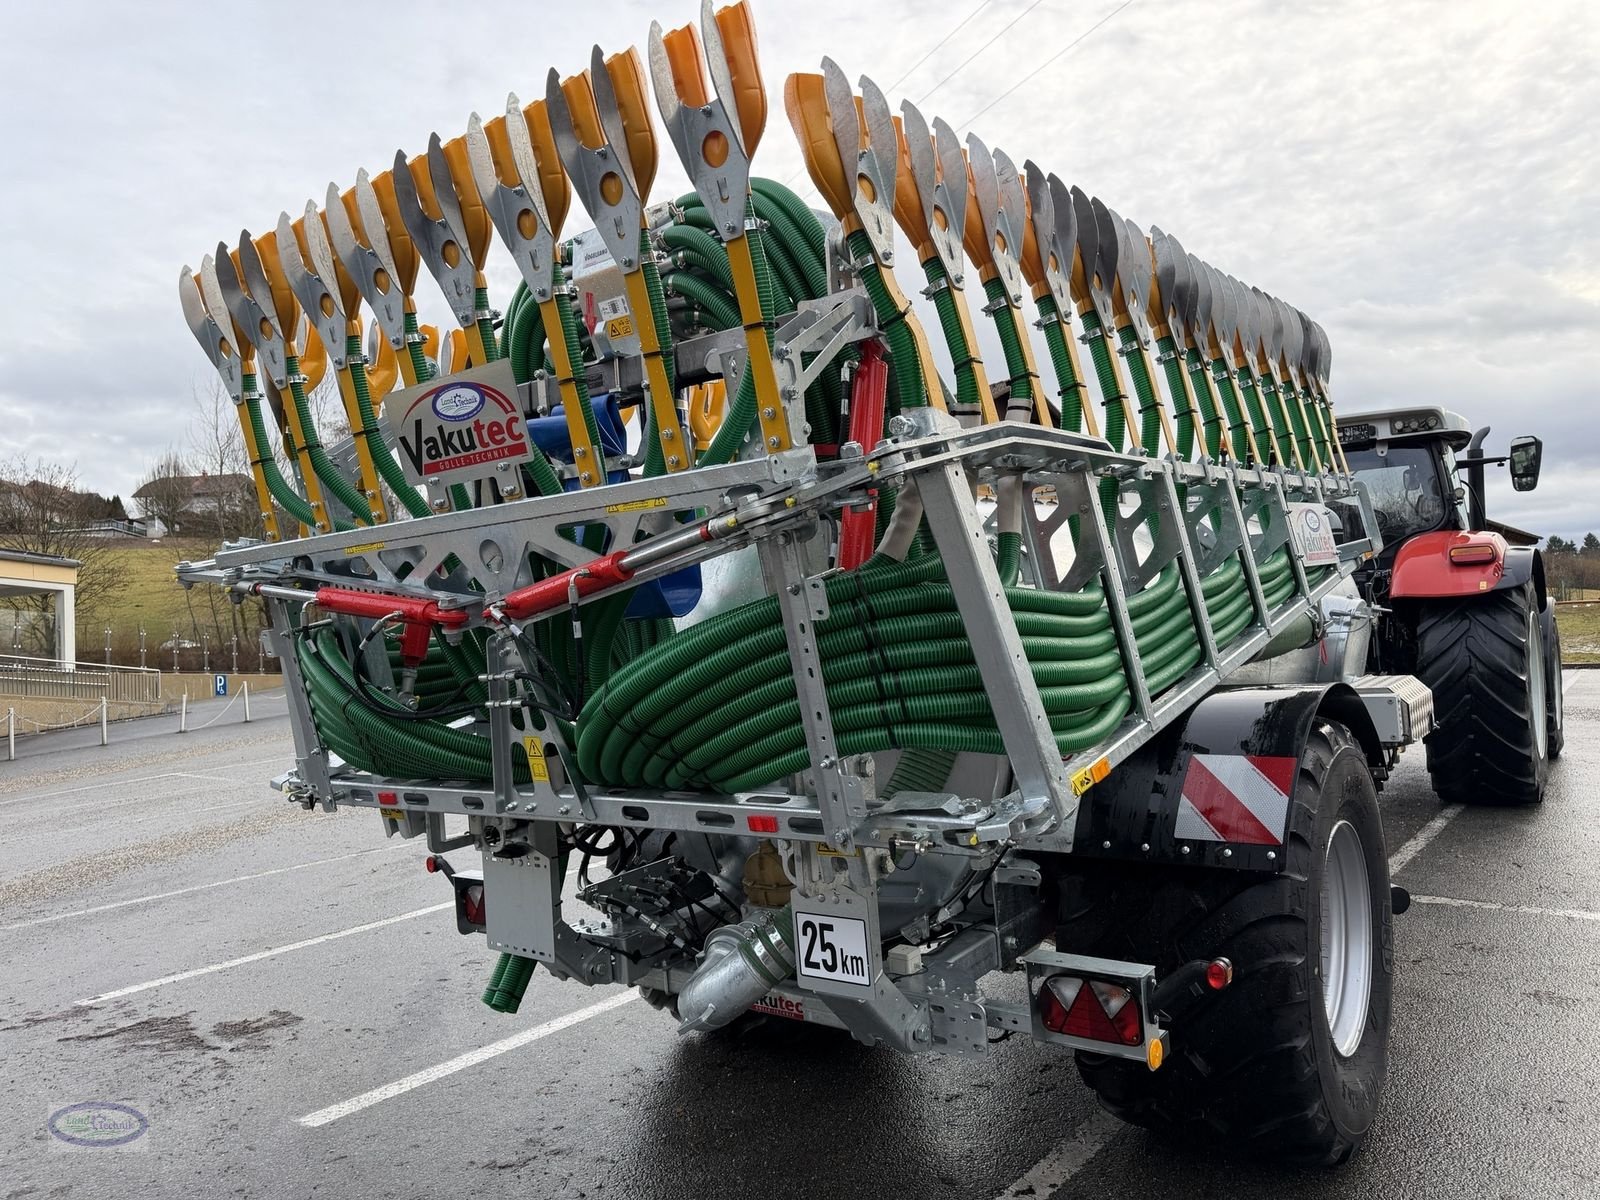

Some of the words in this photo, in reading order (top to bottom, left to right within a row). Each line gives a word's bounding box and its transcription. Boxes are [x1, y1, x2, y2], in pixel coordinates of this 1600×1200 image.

[399, 416, 524, 476] Vakutec
[216, 675, 225, 692] P
[801, 920, 838, 973] 25
[840, 947, 865, 977] km
[756, 995, 804, 1014] kutec
